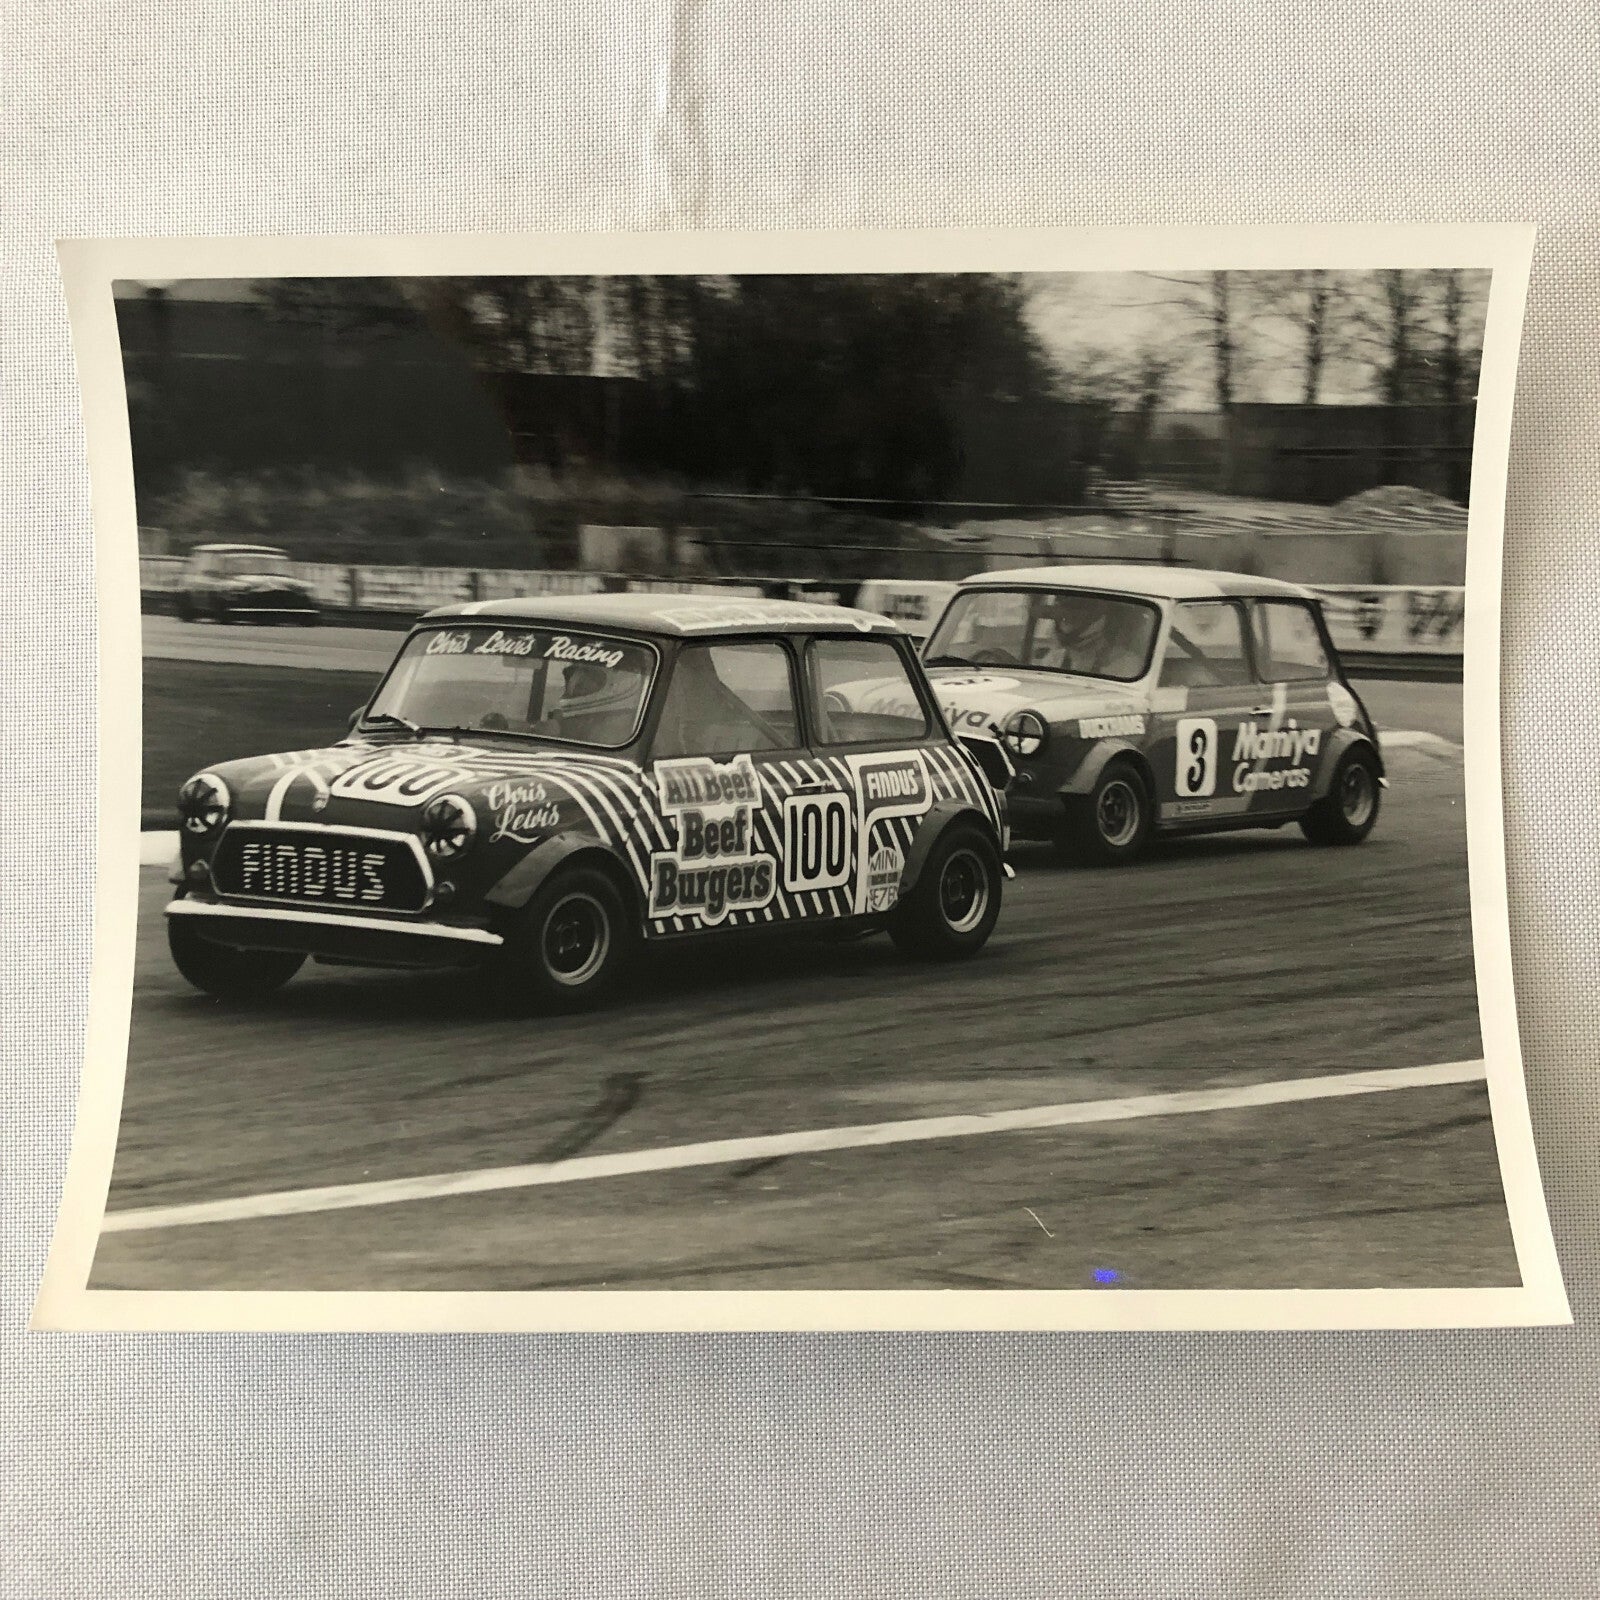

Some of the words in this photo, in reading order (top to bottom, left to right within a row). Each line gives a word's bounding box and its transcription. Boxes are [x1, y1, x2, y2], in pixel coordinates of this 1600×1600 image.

[426, 631, 471, 655] Chris
[544, 636, 624, 668] Racing
[1187, 728, 1207, 793] 3
[1231, 718, 1321, 766] Mamiya
[343, 757, 460, 796] 100
[481, 782, 546, 811] Chris
[703, 761, 758, 803] Beef
[866, 769, 919, 800] FINDUS
[1232, 762, 1311, 793] Cameras
[489, 802, 560, 843] Lewis
[683, 807, 747, 858] Beef
[790, 802, 845, 882] 100
[242, 843, 386, 901] FINDUS
[870, 849, 898, 872] MINI
[655, 861, 771, 916] Burgers
